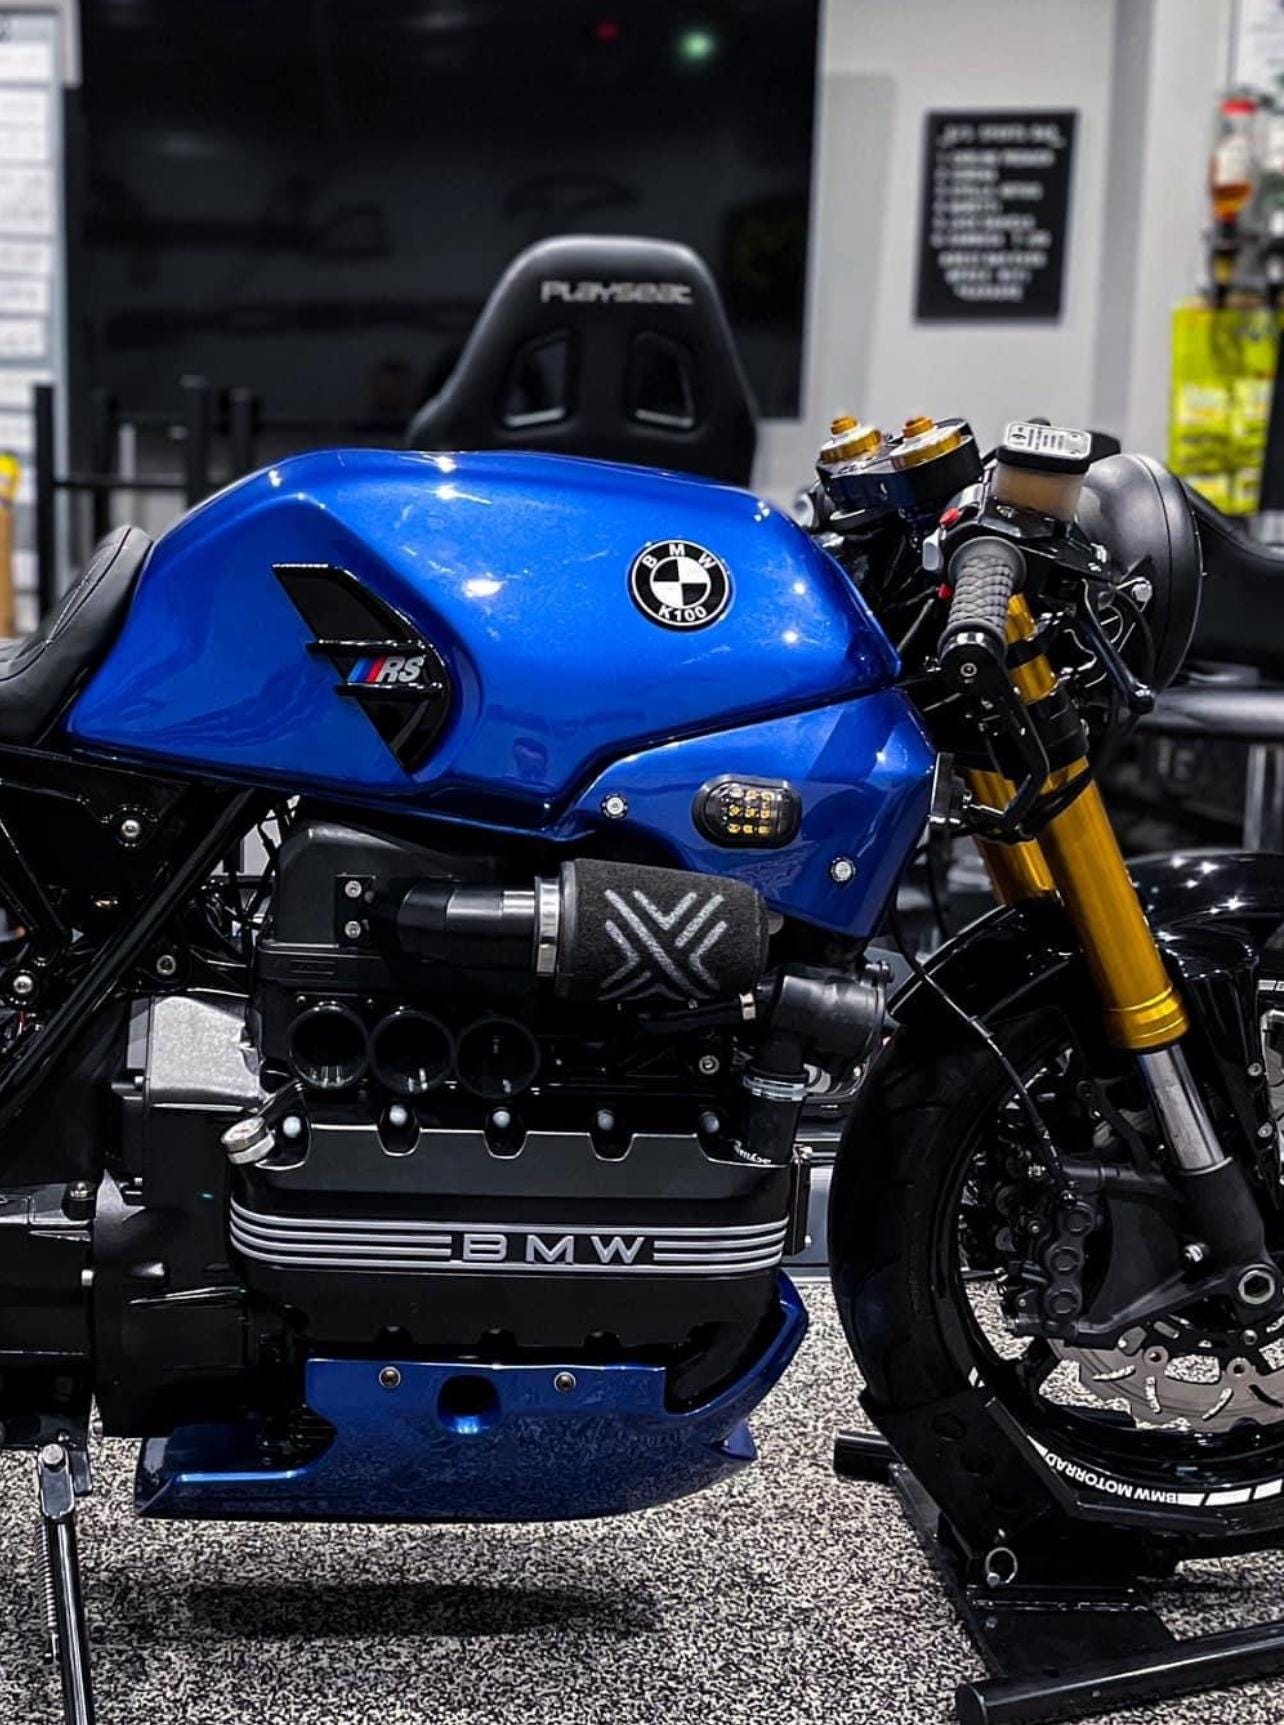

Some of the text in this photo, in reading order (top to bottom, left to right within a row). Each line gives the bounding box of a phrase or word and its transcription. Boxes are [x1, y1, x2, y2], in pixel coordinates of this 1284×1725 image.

[641, 543, 717, 569] BMW
[658, 605, 708, 622] K100
[462, 1233, 646, 1264] BMW
[1044, 1452, 1178, 1504] BMW MOTORRAD
